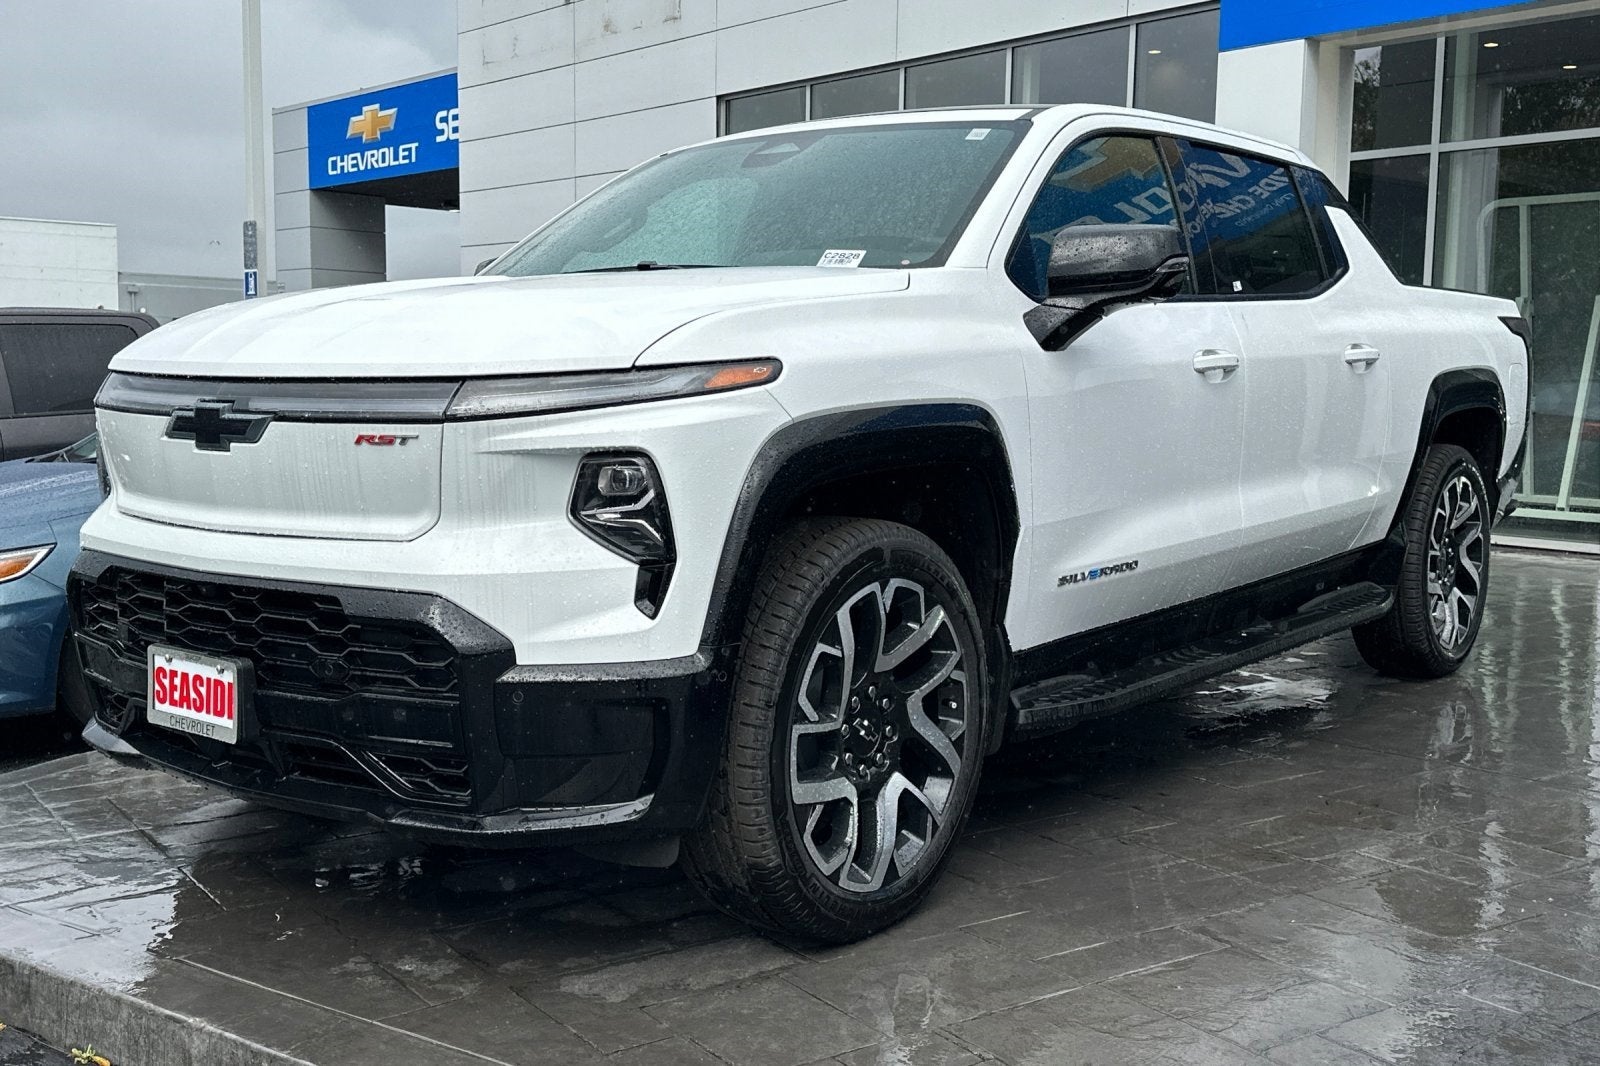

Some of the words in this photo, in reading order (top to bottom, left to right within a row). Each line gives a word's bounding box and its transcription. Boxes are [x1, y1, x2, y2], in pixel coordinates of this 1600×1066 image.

[327, 142, 419, 176] CHEVROLET
[354, 434, 420, 446] RST
[1057, 560, 1139, 587] SILVERADO
[169, 715, 215, 737] CHEVROLET
